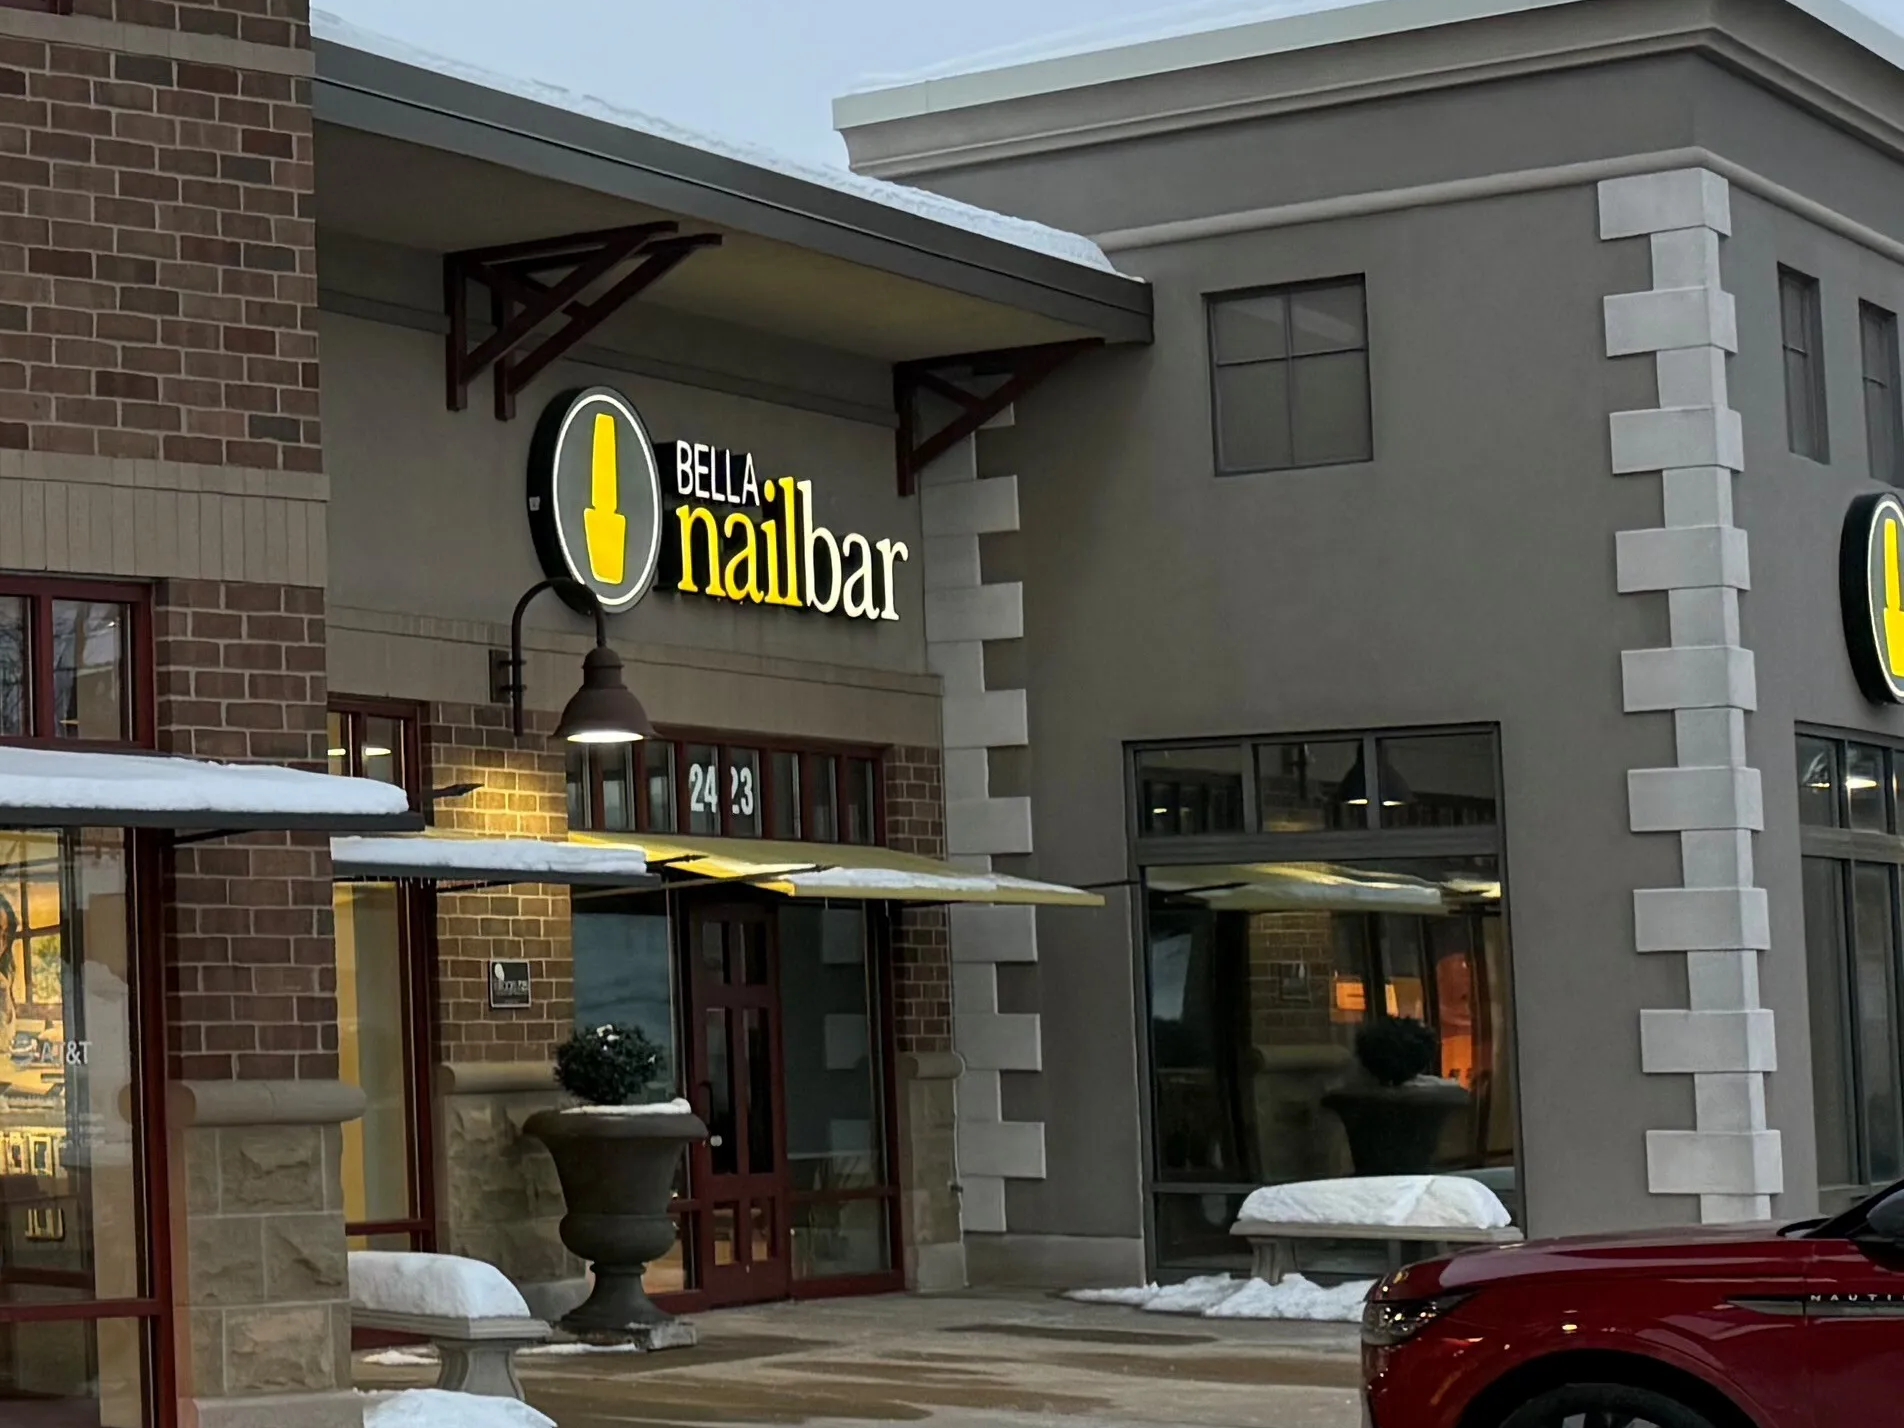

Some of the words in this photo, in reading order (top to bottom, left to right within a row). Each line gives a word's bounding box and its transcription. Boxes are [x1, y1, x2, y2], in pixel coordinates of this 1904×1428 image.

[676, 439, 760, 506] BELLA
[689, 763, 717, 813] 24
[40, 1040, 91, 1065] AT&T
[1810, 1294, 1904, 1302] NAUTI
